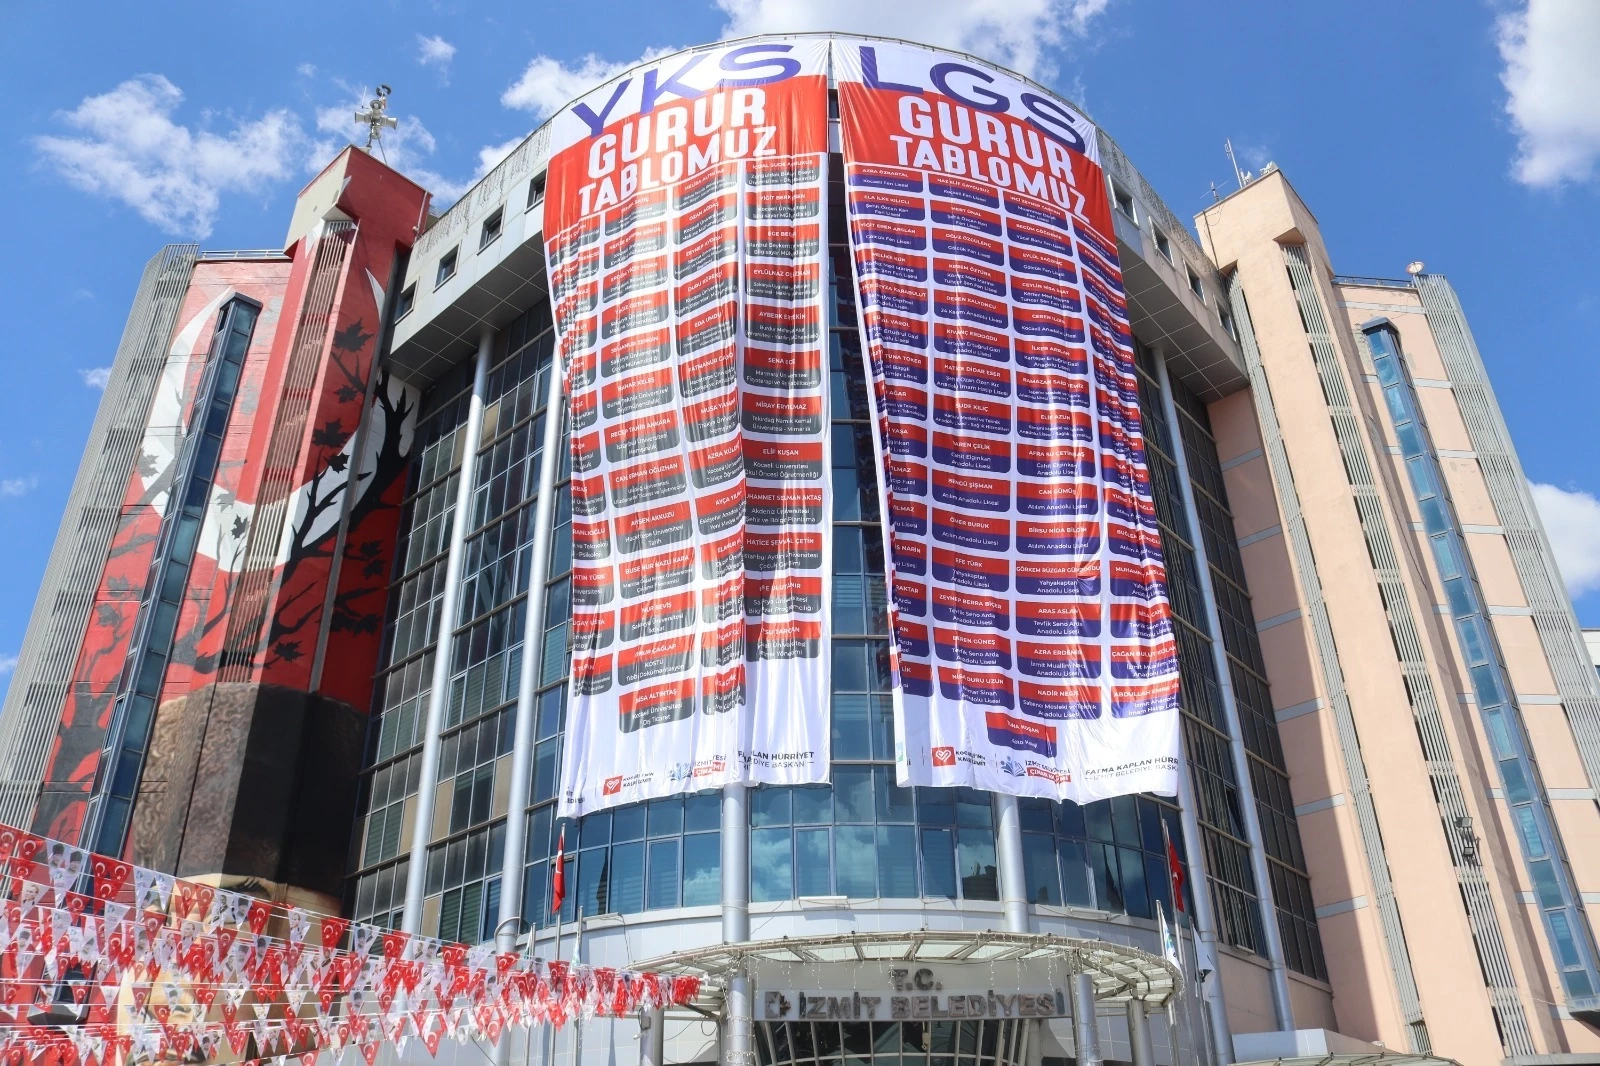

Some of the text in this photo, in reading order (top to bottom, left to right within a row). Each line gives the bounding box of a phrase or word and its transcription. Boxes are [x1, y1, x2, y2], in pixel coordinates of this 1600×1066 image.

[571, 44, 801, 138] YKS
[588, 88, 766, 179] GURUR
[859, 46, 1085, 153] LGS
[579, 126, 776, 217] TABLOMUZ
[890, 135, 1090, 223] TABLOMUZ
[899, 96, 1076, 187] GURUR
[1085, 758, 1152, 776] FATMA KAPLAN
[799, 988, 1066, 1019] İZMİT BELEDİYESİ
[889, 968, 943, 991] T.C.
